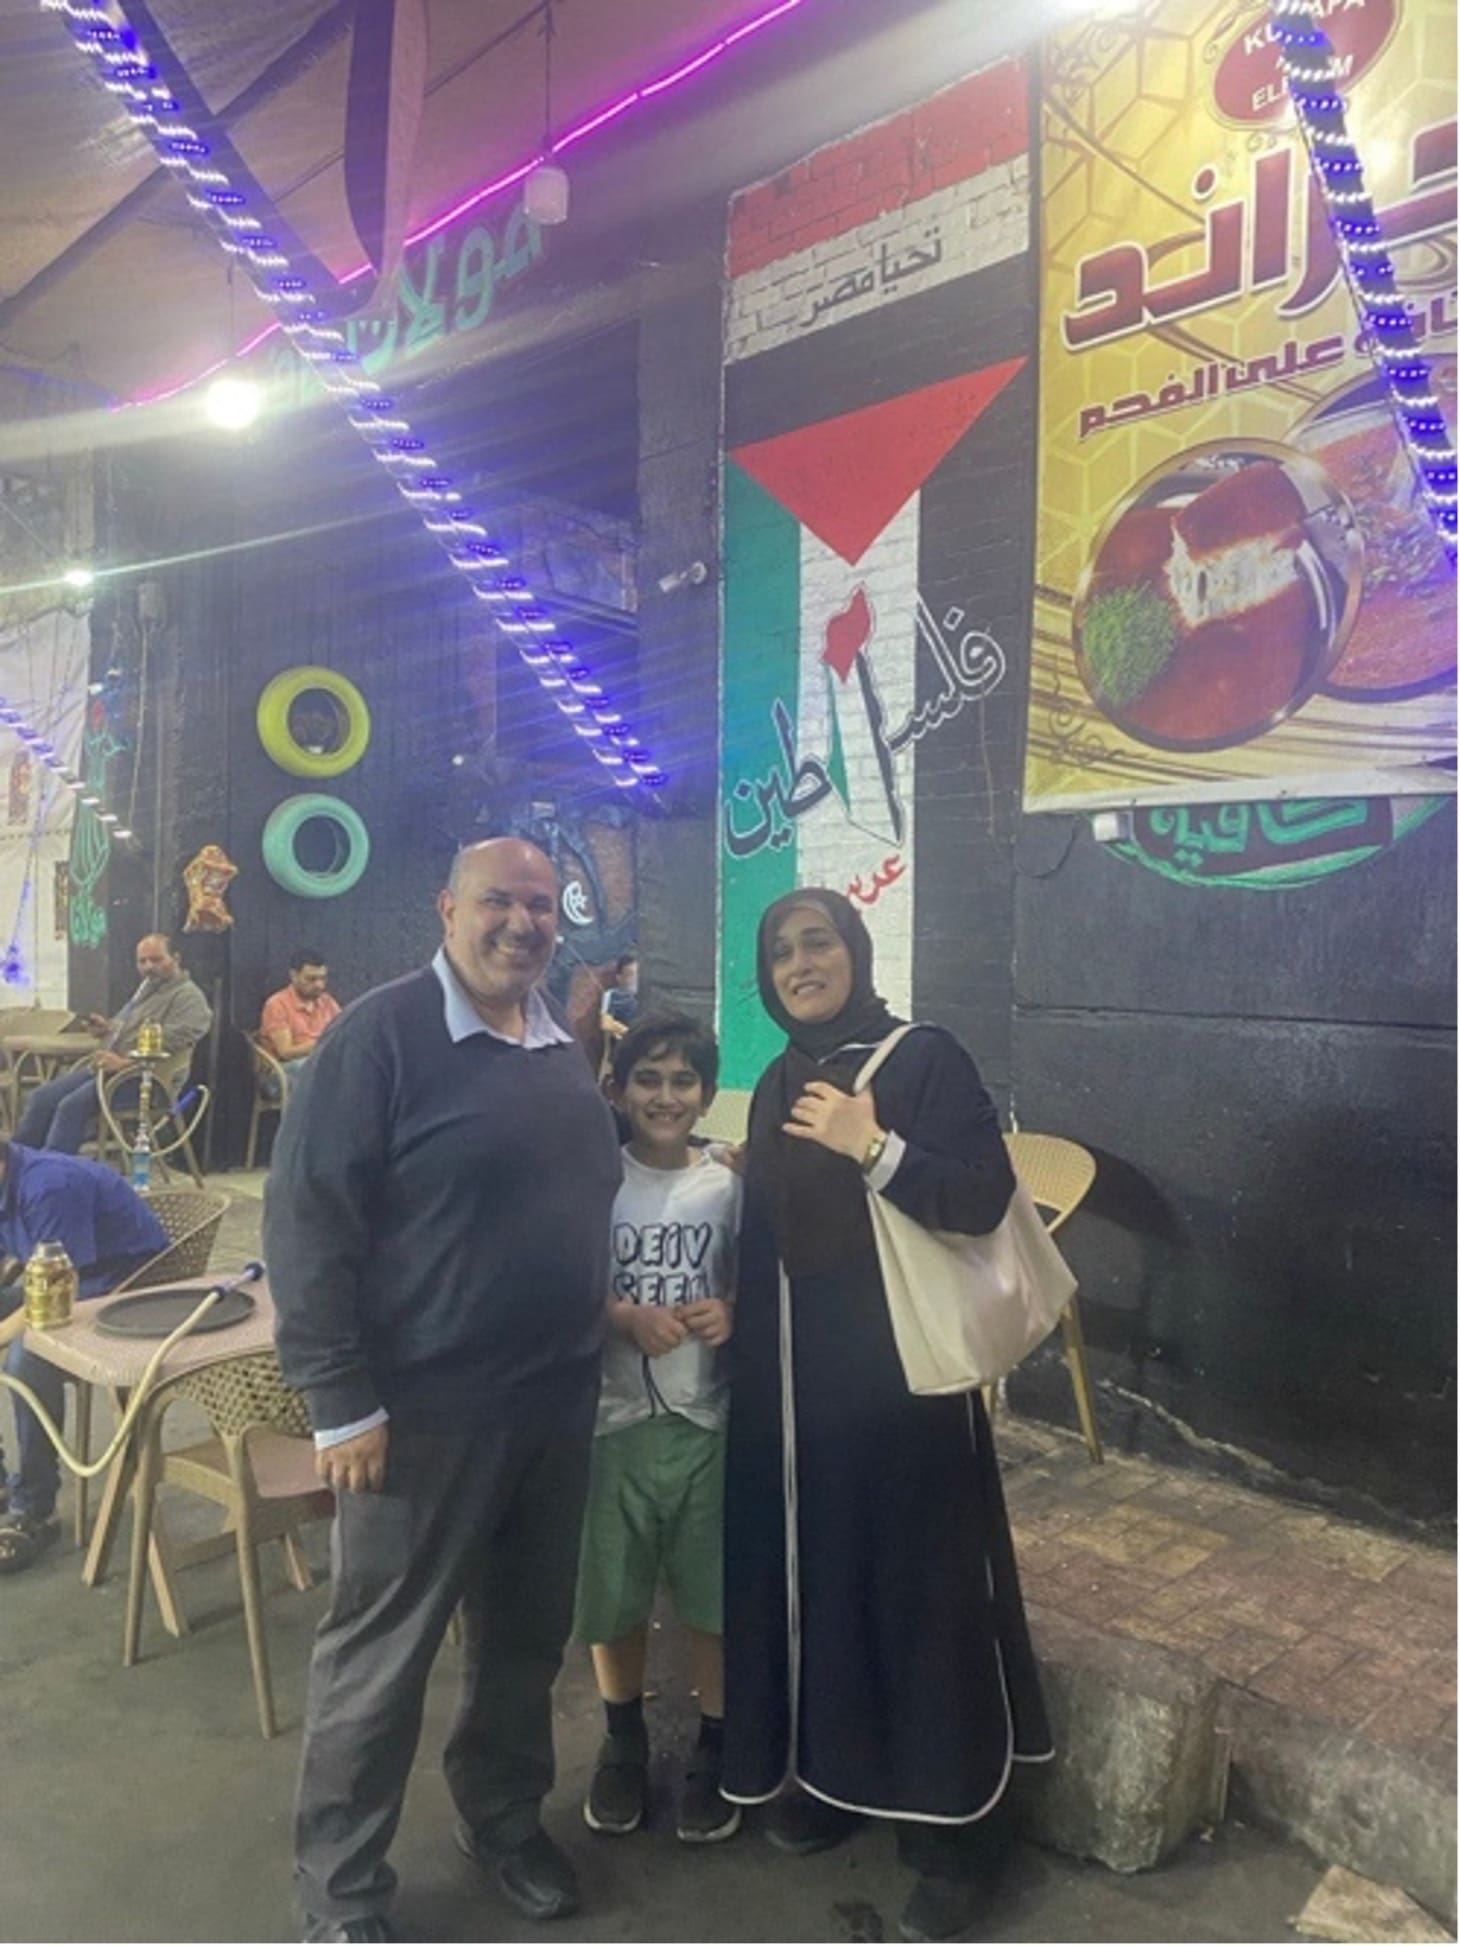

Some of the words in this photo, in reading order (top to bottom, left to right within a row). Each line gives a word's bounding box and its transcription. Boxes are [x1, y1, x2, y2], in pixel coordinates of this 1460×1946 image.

[873, 225, 942, 295] تحيا
[800, 271, 874, 328] مصر
[1226, 336, 1345, 390] على
[1079, 364, 1220, 438] الفحم
